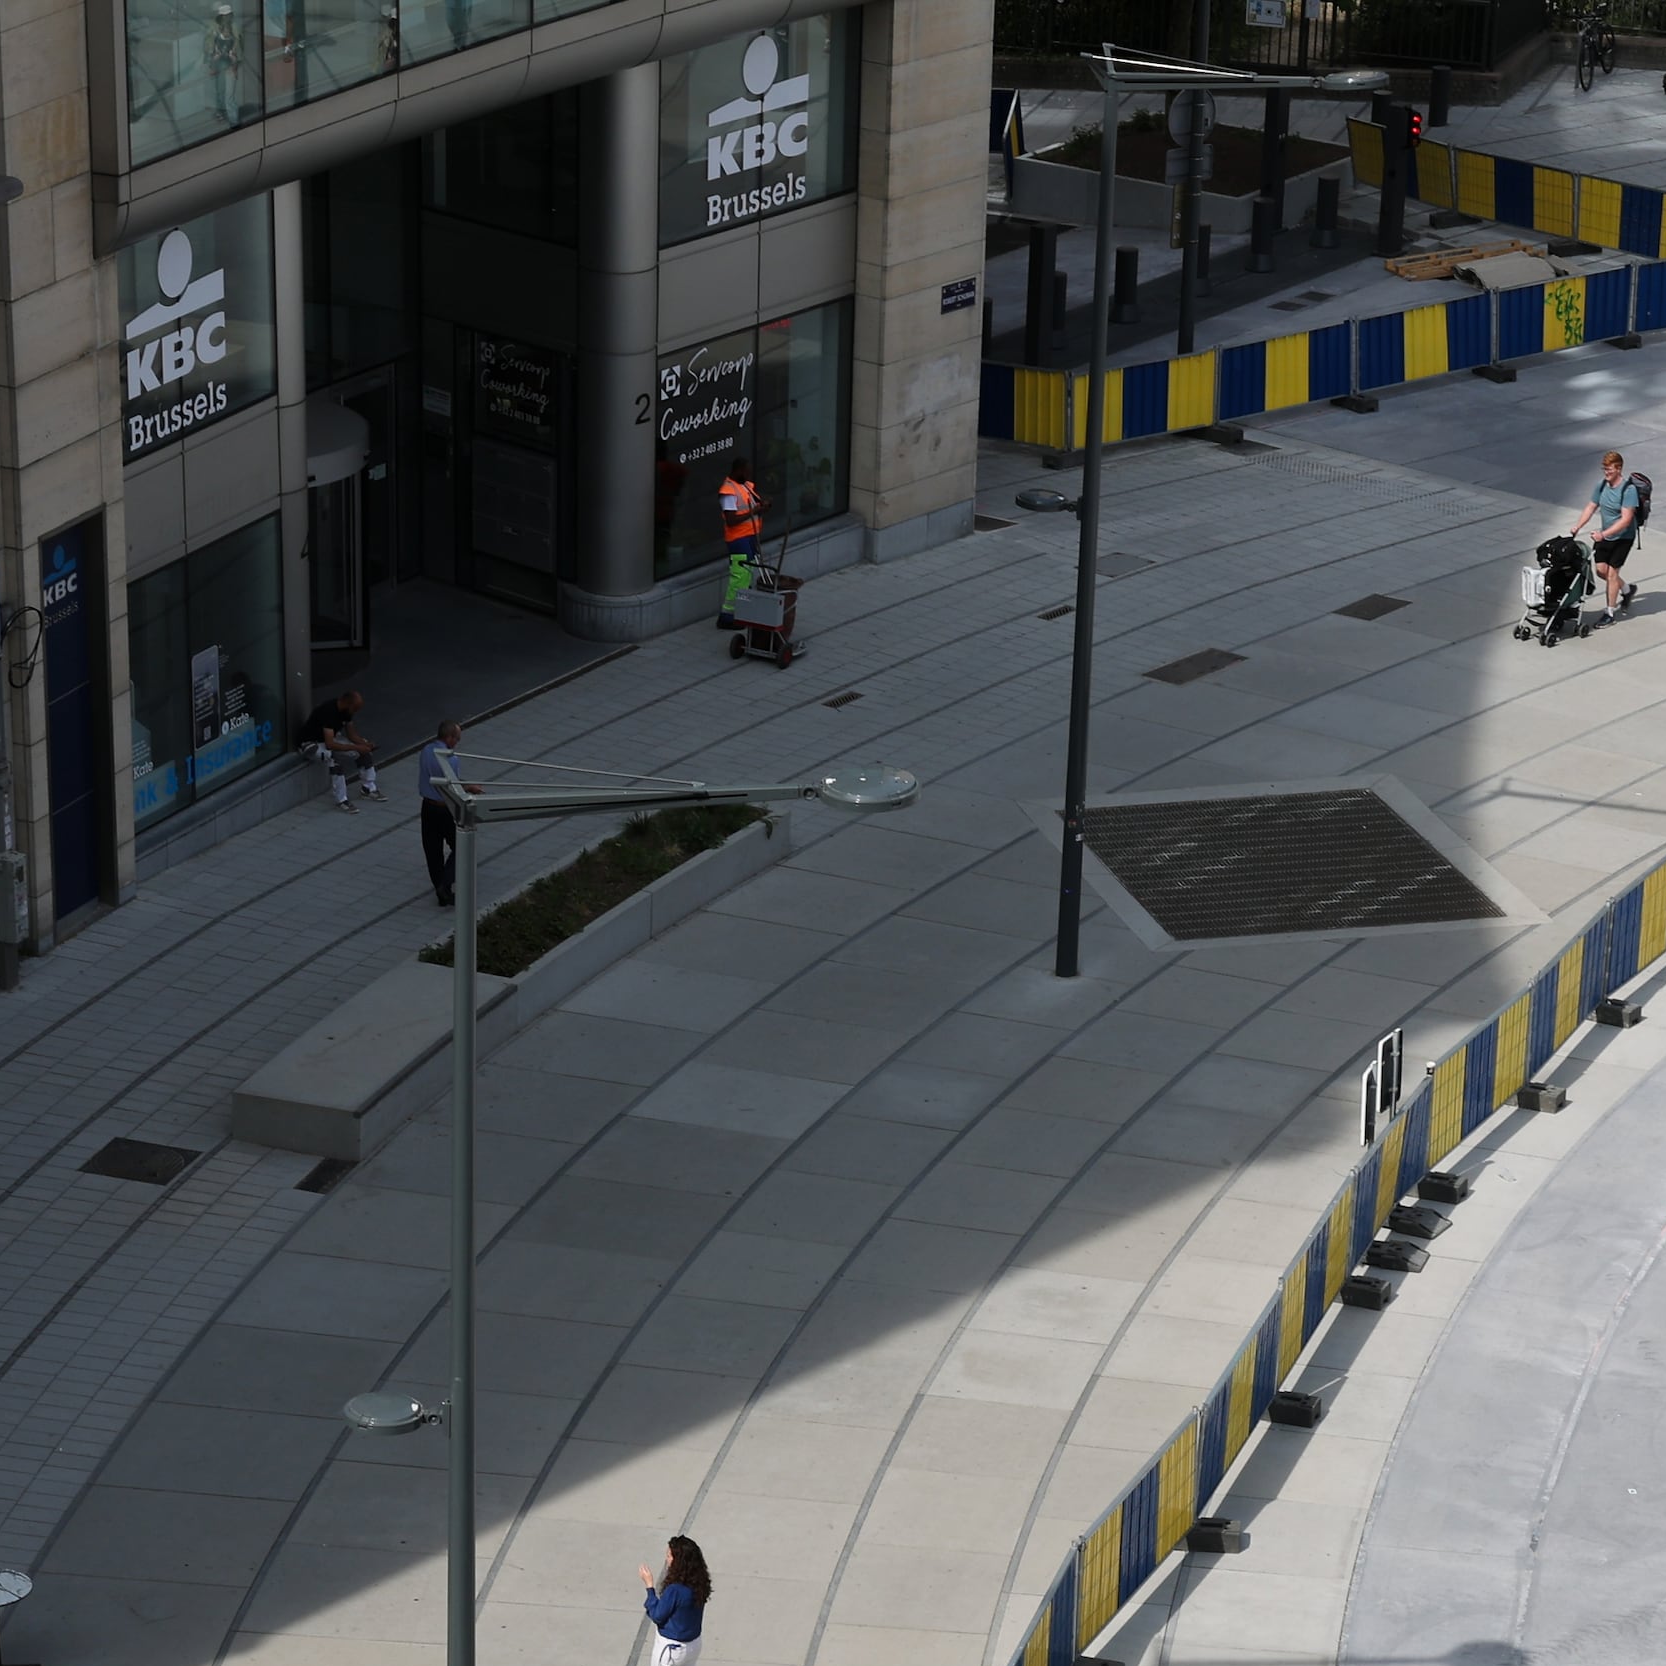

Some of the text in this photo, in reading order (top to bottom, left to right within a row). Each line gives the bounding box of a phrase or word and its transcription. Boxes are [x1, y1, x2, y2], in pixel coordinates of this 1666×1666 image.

[707, 111, 808, 181] KBC
[706, 172, 806, 227] Brussels
[126, 311, 227, 400] KBC
[687, 347, 754, 396] Servcorp
[128, 381, 228, 452] Brussels
[635, 393, 651, 425] 2
[660, 397, 753, 441] Coworking
[43, 572, 77, 607] KBC
[229, 711, 250, 731] Kate
[132, 760, 154, 780] Kate
[165, 767, 181, 795] &
[184, 719, 273, 786] Insurance
